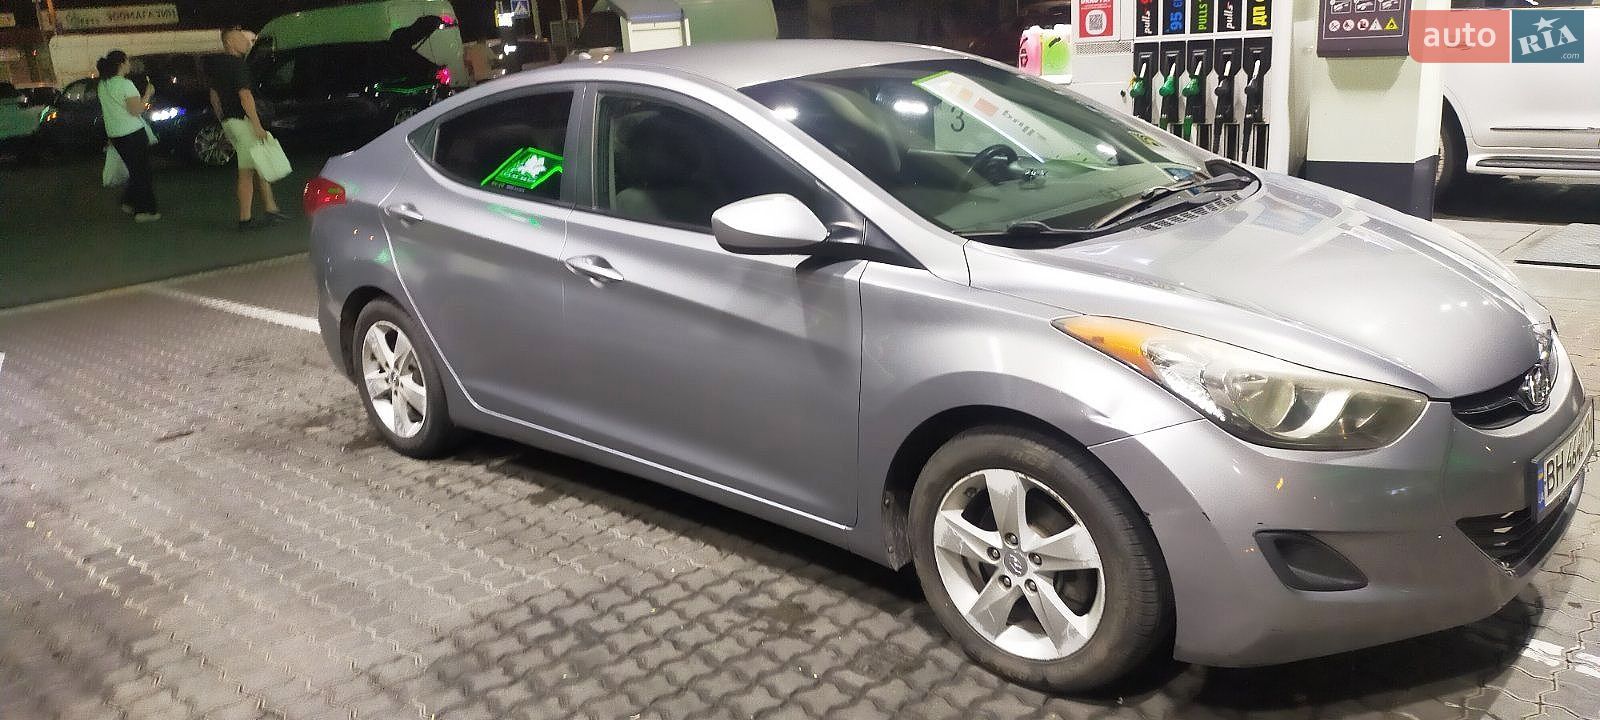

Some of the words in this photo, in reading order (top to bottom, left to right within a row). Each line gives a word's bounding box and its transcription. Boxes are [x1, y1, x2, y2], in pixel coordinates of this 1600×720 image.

[1142, 9, 1152, 35] pulls
[1169, 11, 1183, 31] 95
[1198, 3, 1208, 31] PULLS
[1223, 2, 1235, 29] pulls
[1252, 6, 1267, 26] ДП
[1546, 449, 1564, 497] BH
